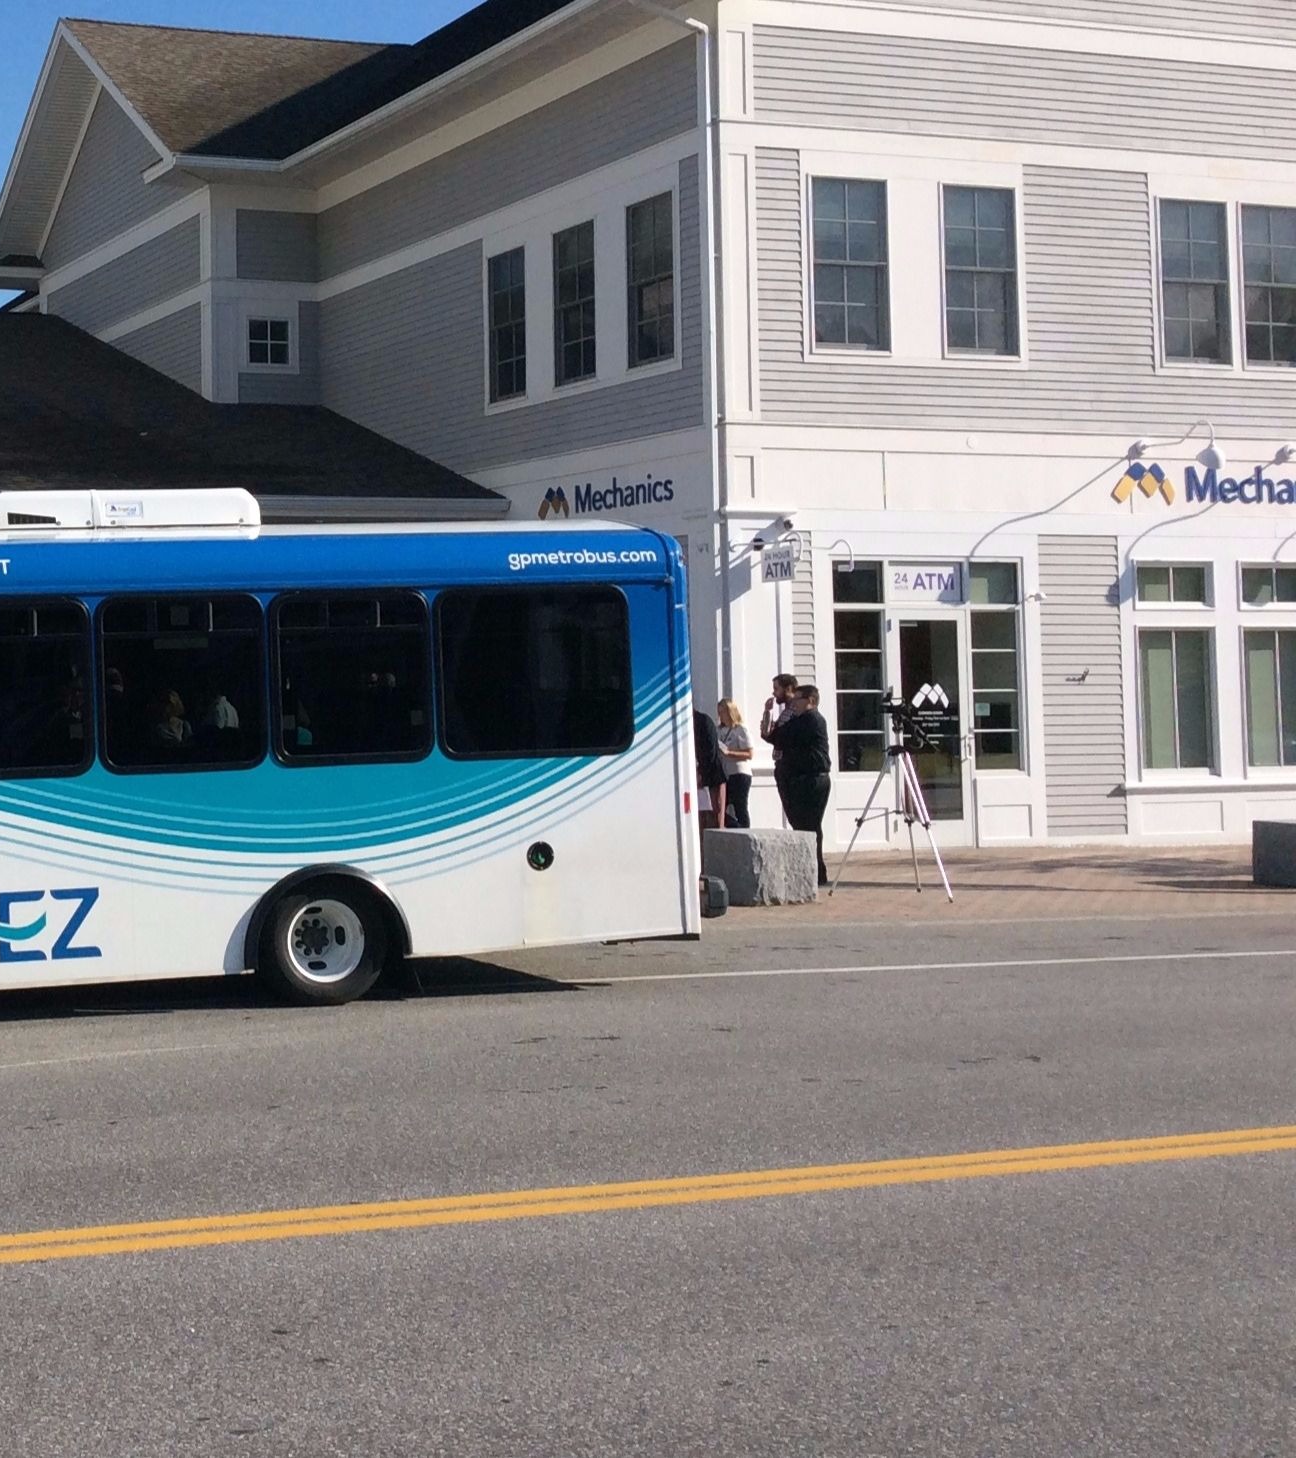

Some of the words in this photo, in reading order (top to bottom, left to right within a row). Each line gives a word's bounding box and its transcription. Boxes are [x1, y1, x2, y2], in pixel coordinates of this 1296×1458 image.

[574, 473, 674, 514] Mechanics
[1184, 465, 1296, 505] Mecha
[508, 549, 657, 570] gpmetrobus.com
[765, 561, 792, 579] ATM
[894, 572, 908, 584] 24
[912, 572, 955, 591] ATM
